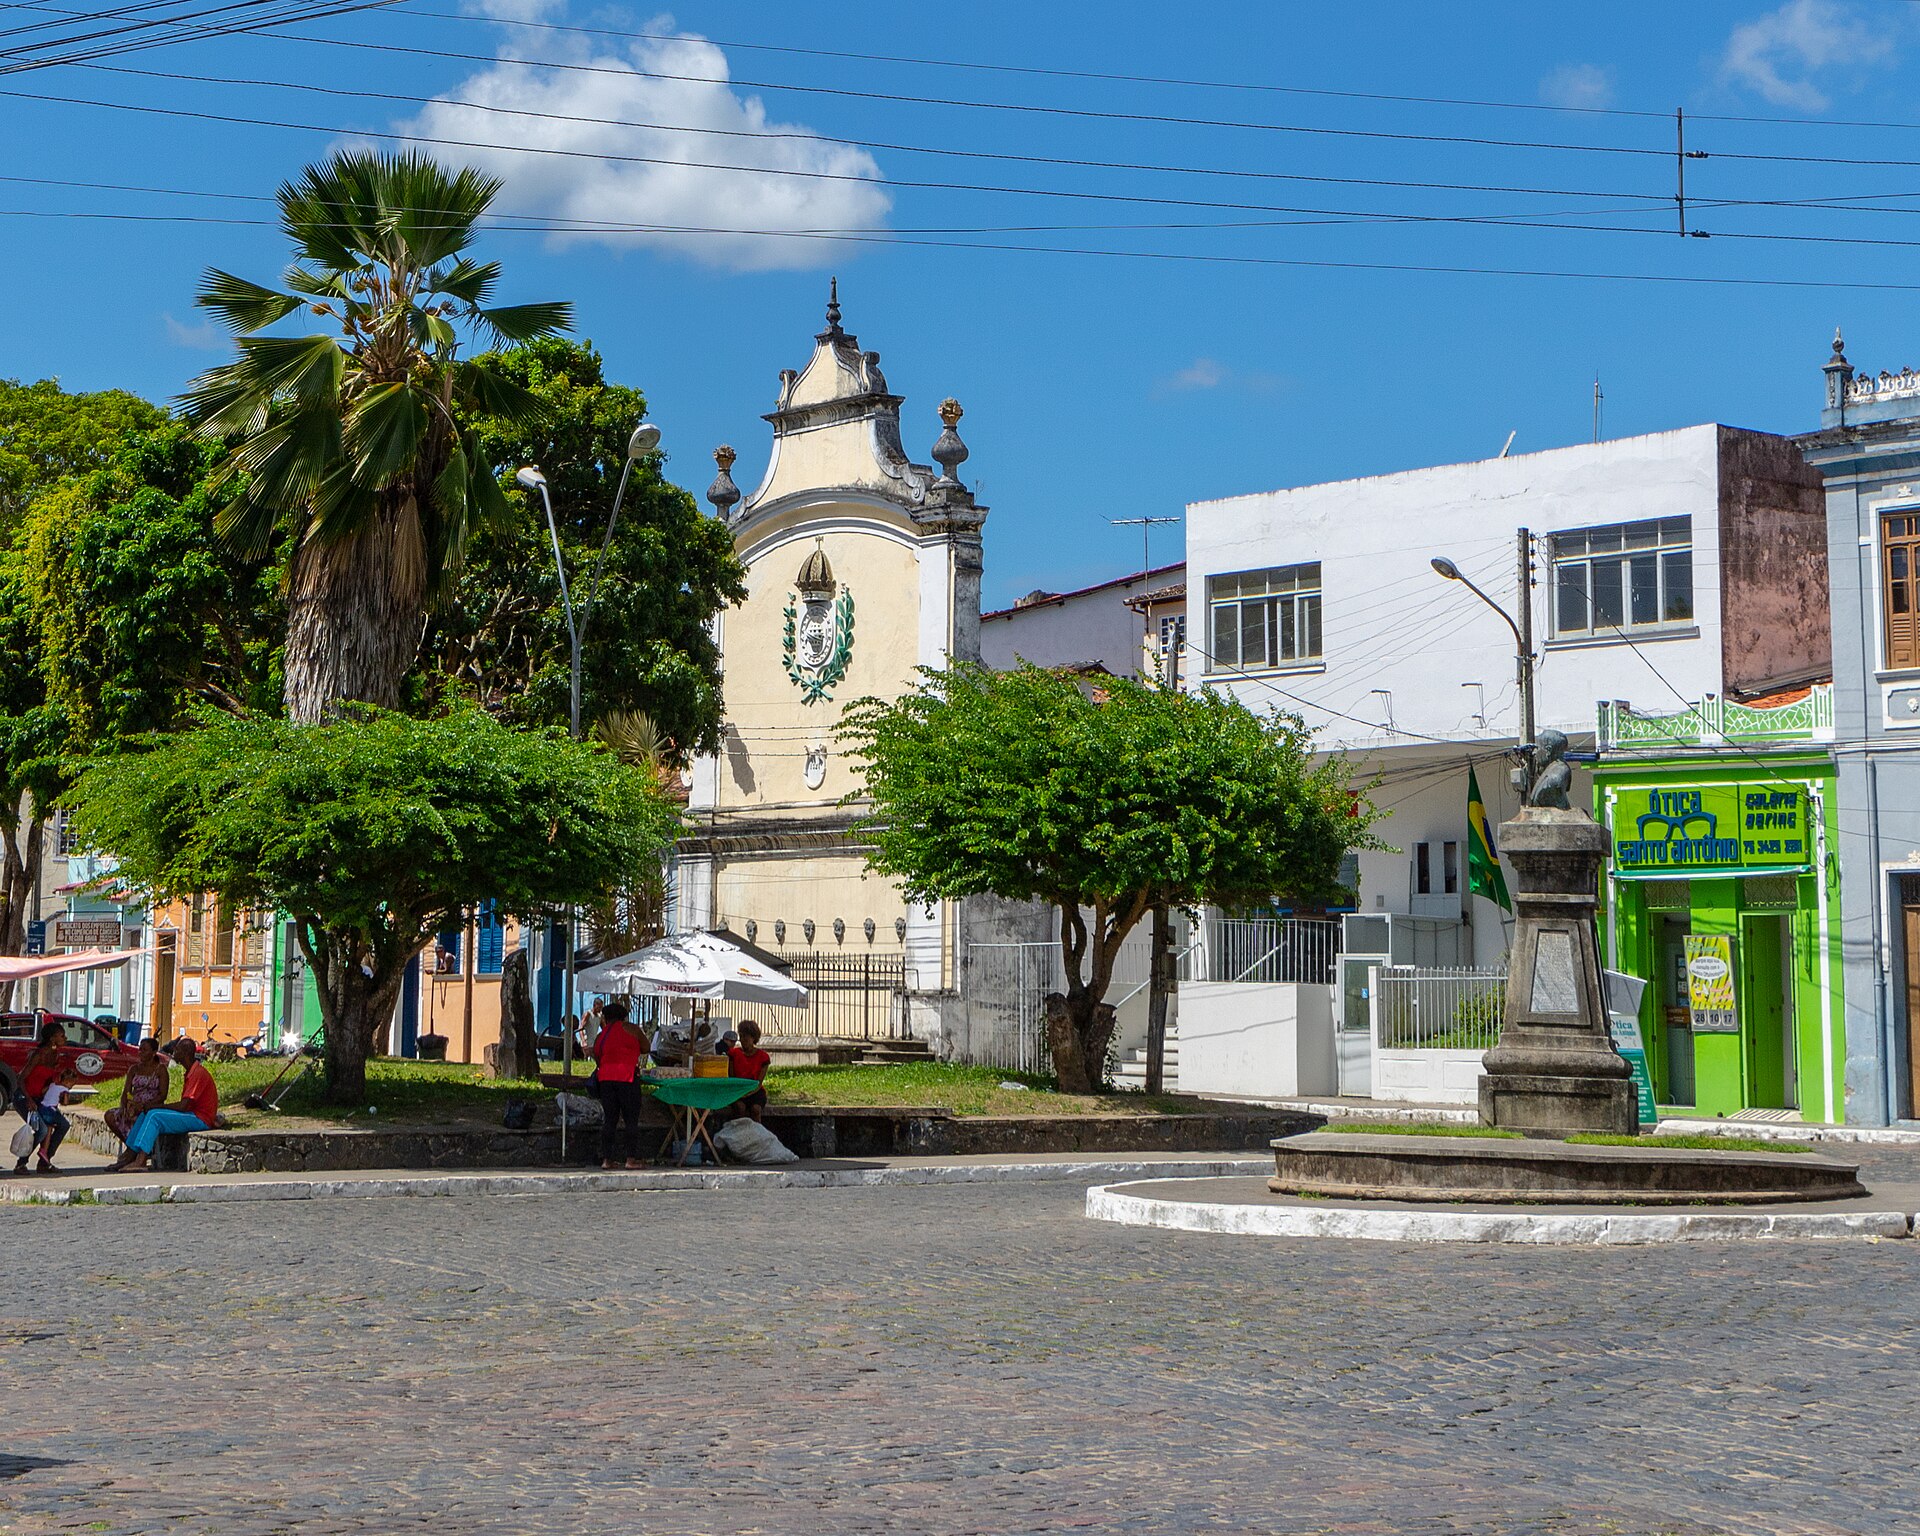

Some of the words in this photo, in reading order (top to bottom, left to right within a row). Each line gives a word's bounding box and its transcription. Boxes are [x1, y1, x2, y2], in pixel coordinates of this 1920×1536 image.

[1649, 788, 1702, 816] ÓTICA
[1617, 840, 1668, 864] SANTO
[1695, 1013, 1705, 1023] 28
[1710, 1013, 1720, 1023] 10
[1724, 1014, 1733, 1023] 17
